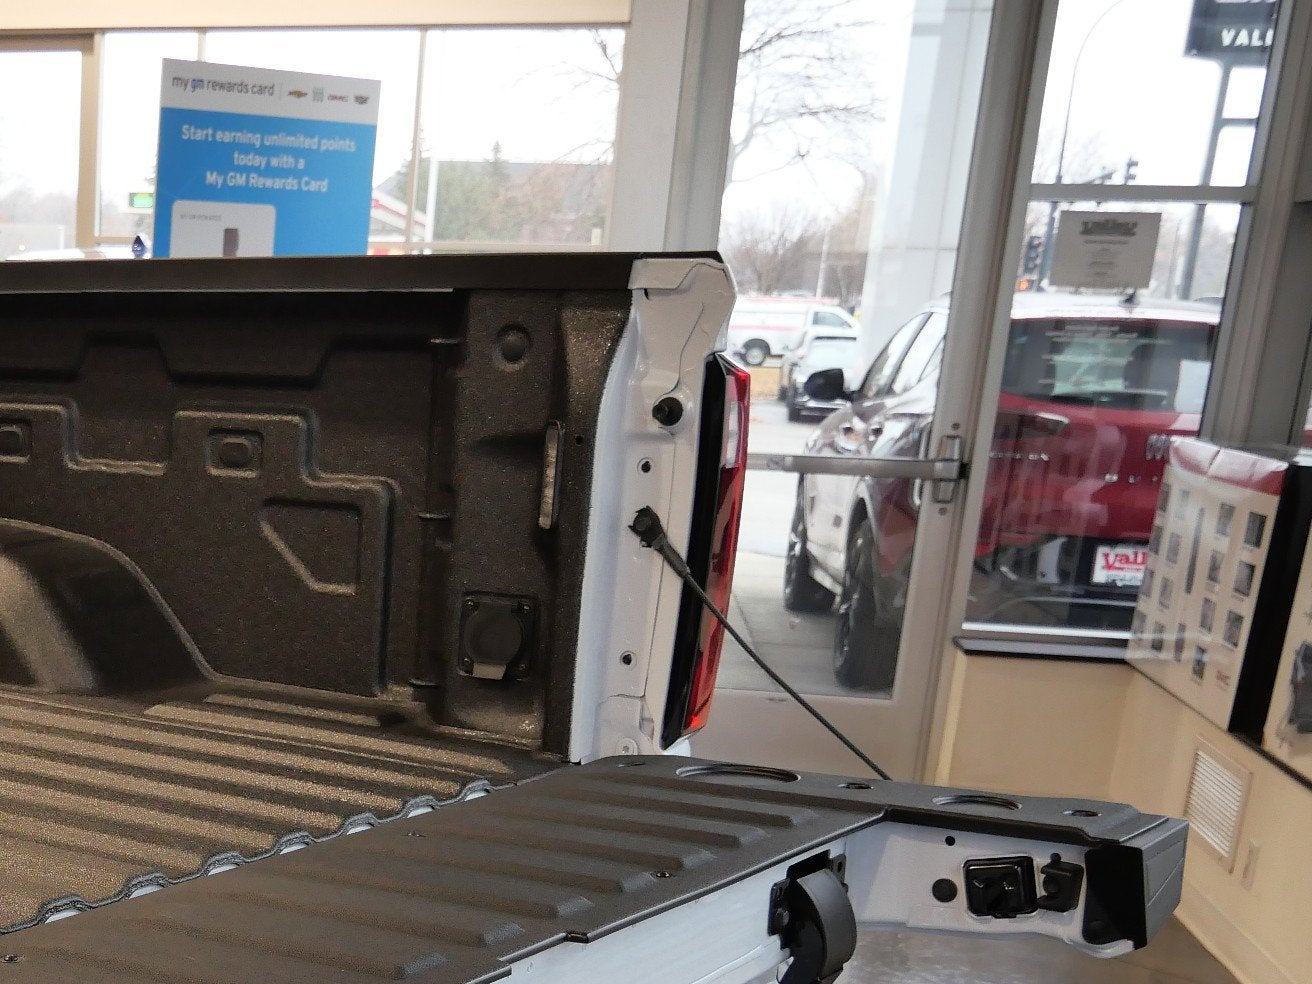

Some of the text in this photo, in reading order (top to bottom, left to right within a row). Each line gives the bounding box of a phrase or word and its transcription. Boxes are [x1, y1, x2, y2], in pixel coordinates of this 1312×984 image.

[172, 76, 275, 97] my gm rewards card
[181, 124, 356, 153] Start earning unlimited points
[233, 151, 305, 169] today with a
[206, 171, 328, 192] My GM Rewards Card
